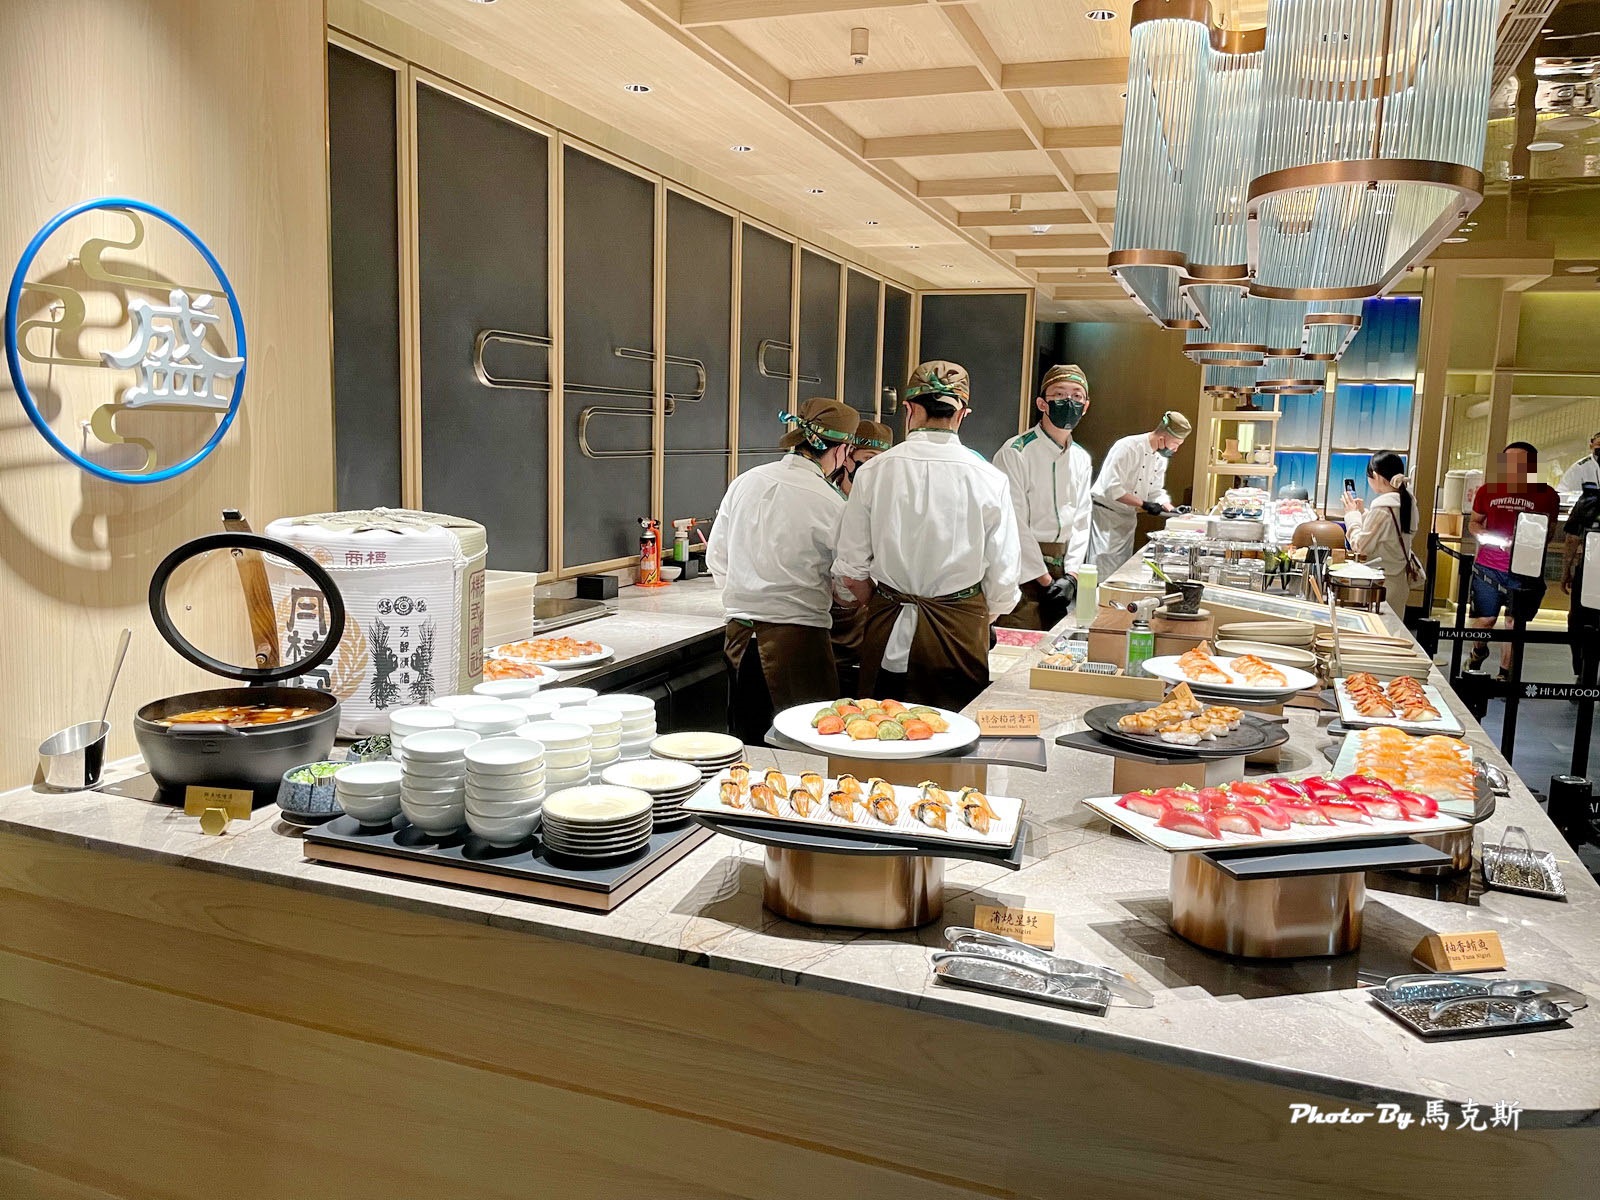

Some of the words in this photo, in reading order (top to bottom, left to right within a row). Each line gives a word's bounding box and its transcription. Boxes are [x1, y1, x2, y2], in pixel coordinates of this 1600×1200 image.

[100, 289, 245, 407] 盛
[1489, 496, 1535, 510] POWERLIFTING
[345, 550, 387, 566] 商標
[1461, 631, 1492, 639] FOODS
